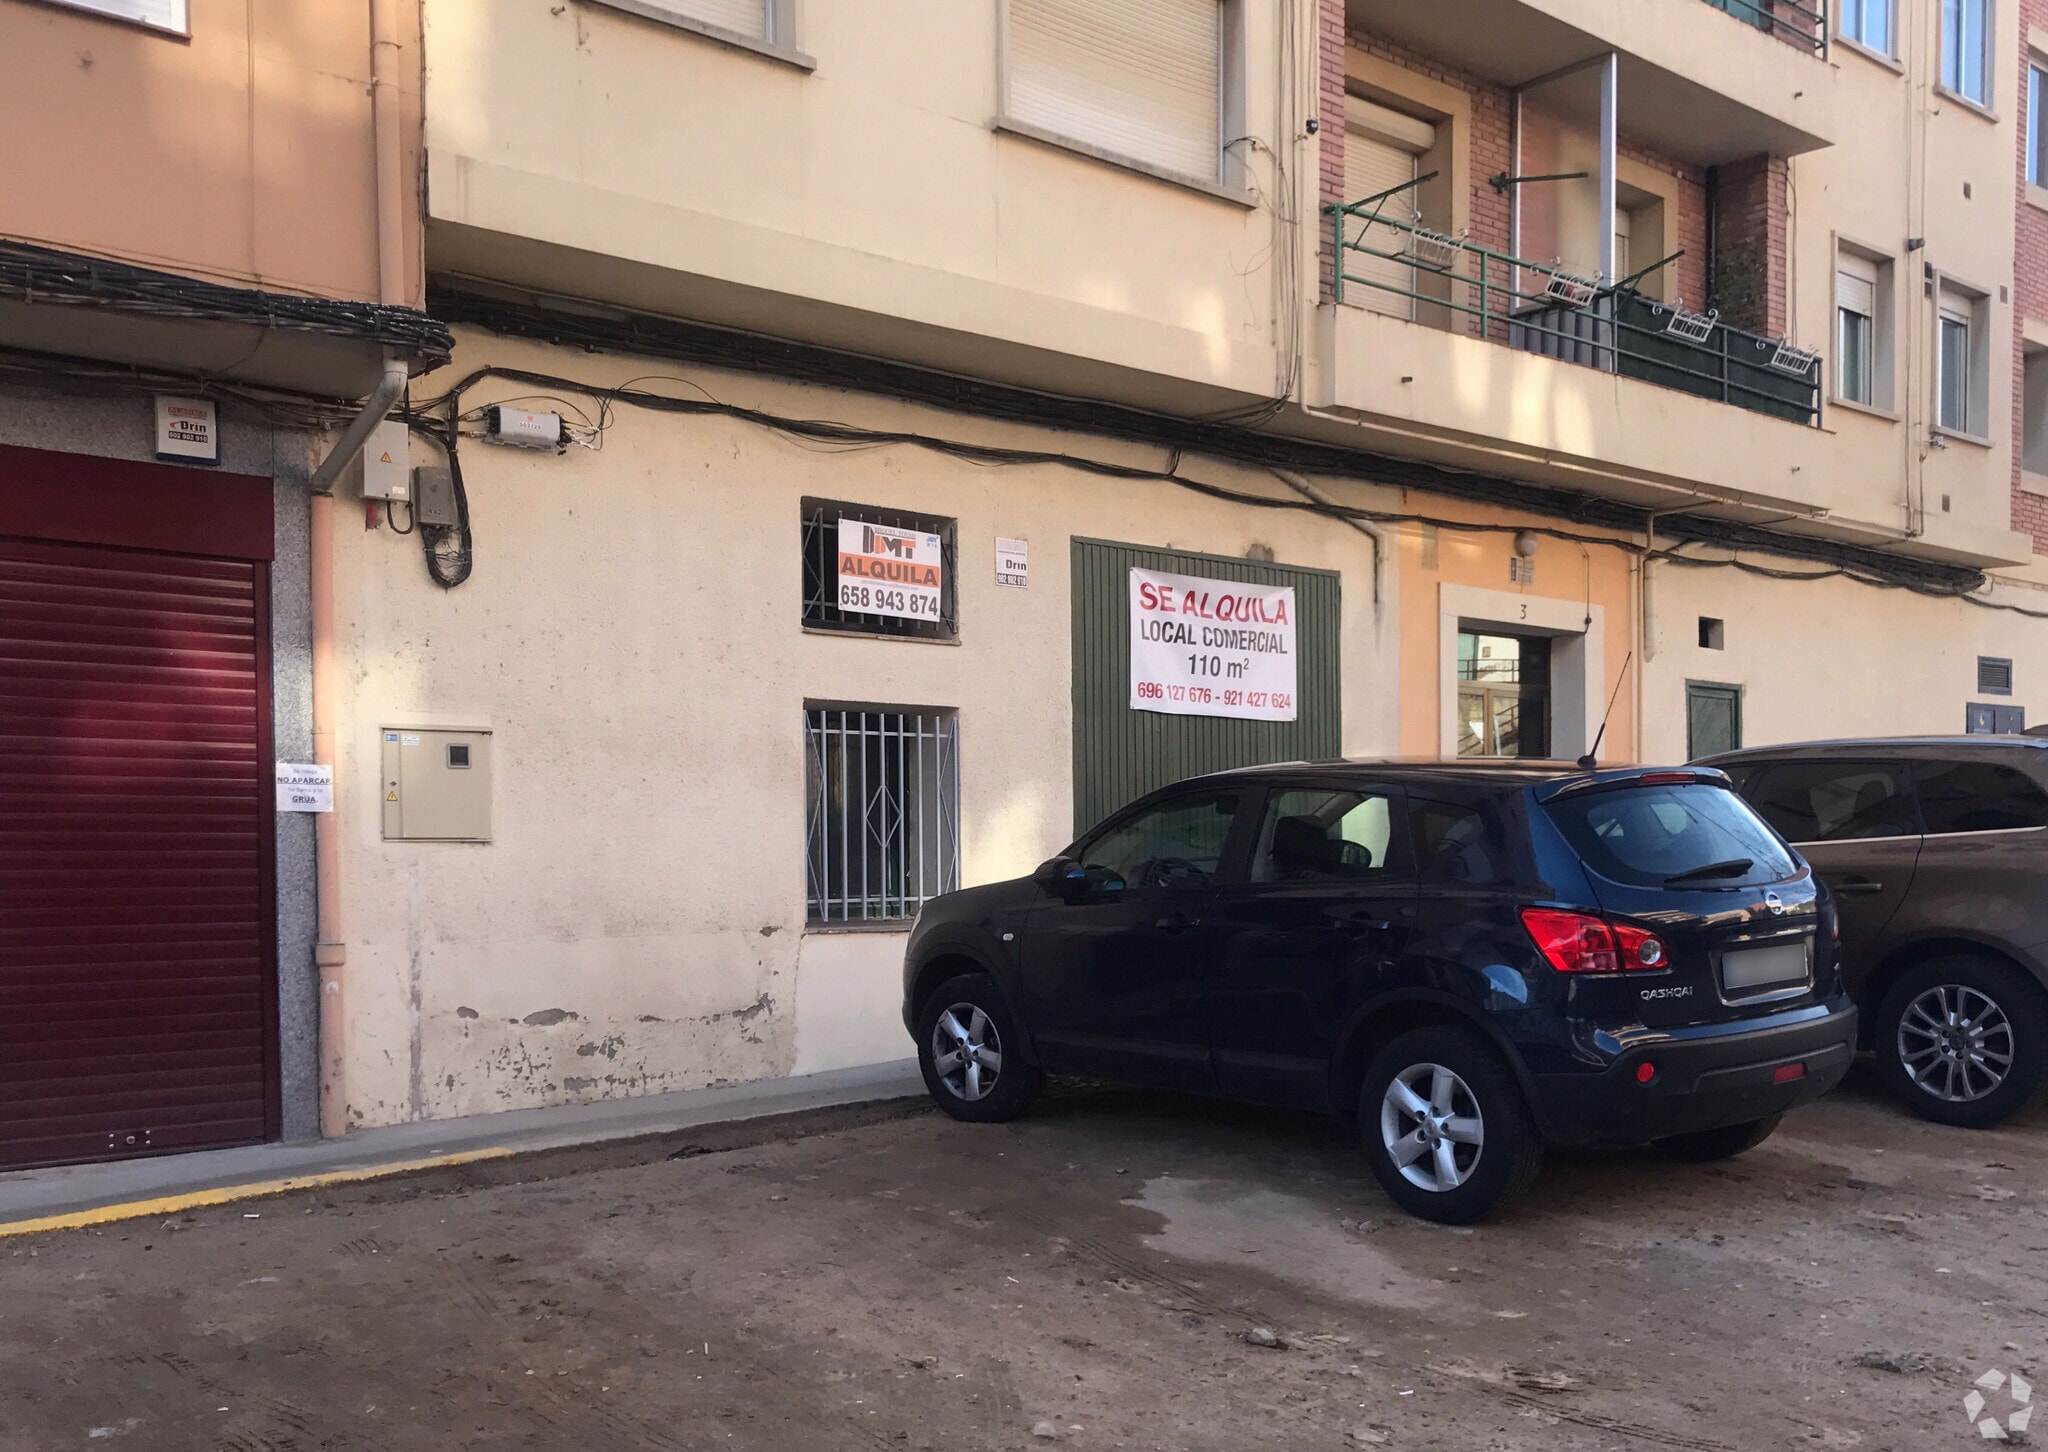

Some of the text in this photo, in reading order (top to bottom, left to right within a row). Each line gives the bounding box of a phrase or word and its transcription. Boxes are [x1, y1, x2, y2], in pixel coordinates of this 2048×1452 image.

[181, 421, 206, 433] Drin
[841, 556, 938, 586] ALQUILA
[1005, 559, 1027, 571] Drin
[841, 584, 870, 608] 658
[875, 589, 905, 612] 943
[909, 593, 938, 616] 874
[1139, 582, 1289, 626] SE ALQUILA
[1520, 604, 1528, 620] 3
[1140, 618, 1288, 655] LOCAL COMERCIAL
[1188, 653, 1221, 677] 110
[1137, 681, 1164, 699] 696
[1166, 684, 1186, 702] 127
[1188, 687, 1212, 704] 676
[1223, 689, 1243, 706] 921
[1247, 691, 1268, 708] 427
[1271, 693, 1292, 709] 624
[277, 776, 290, 784] NO
[1639, 986, 1694, 1001] QASHQAI
